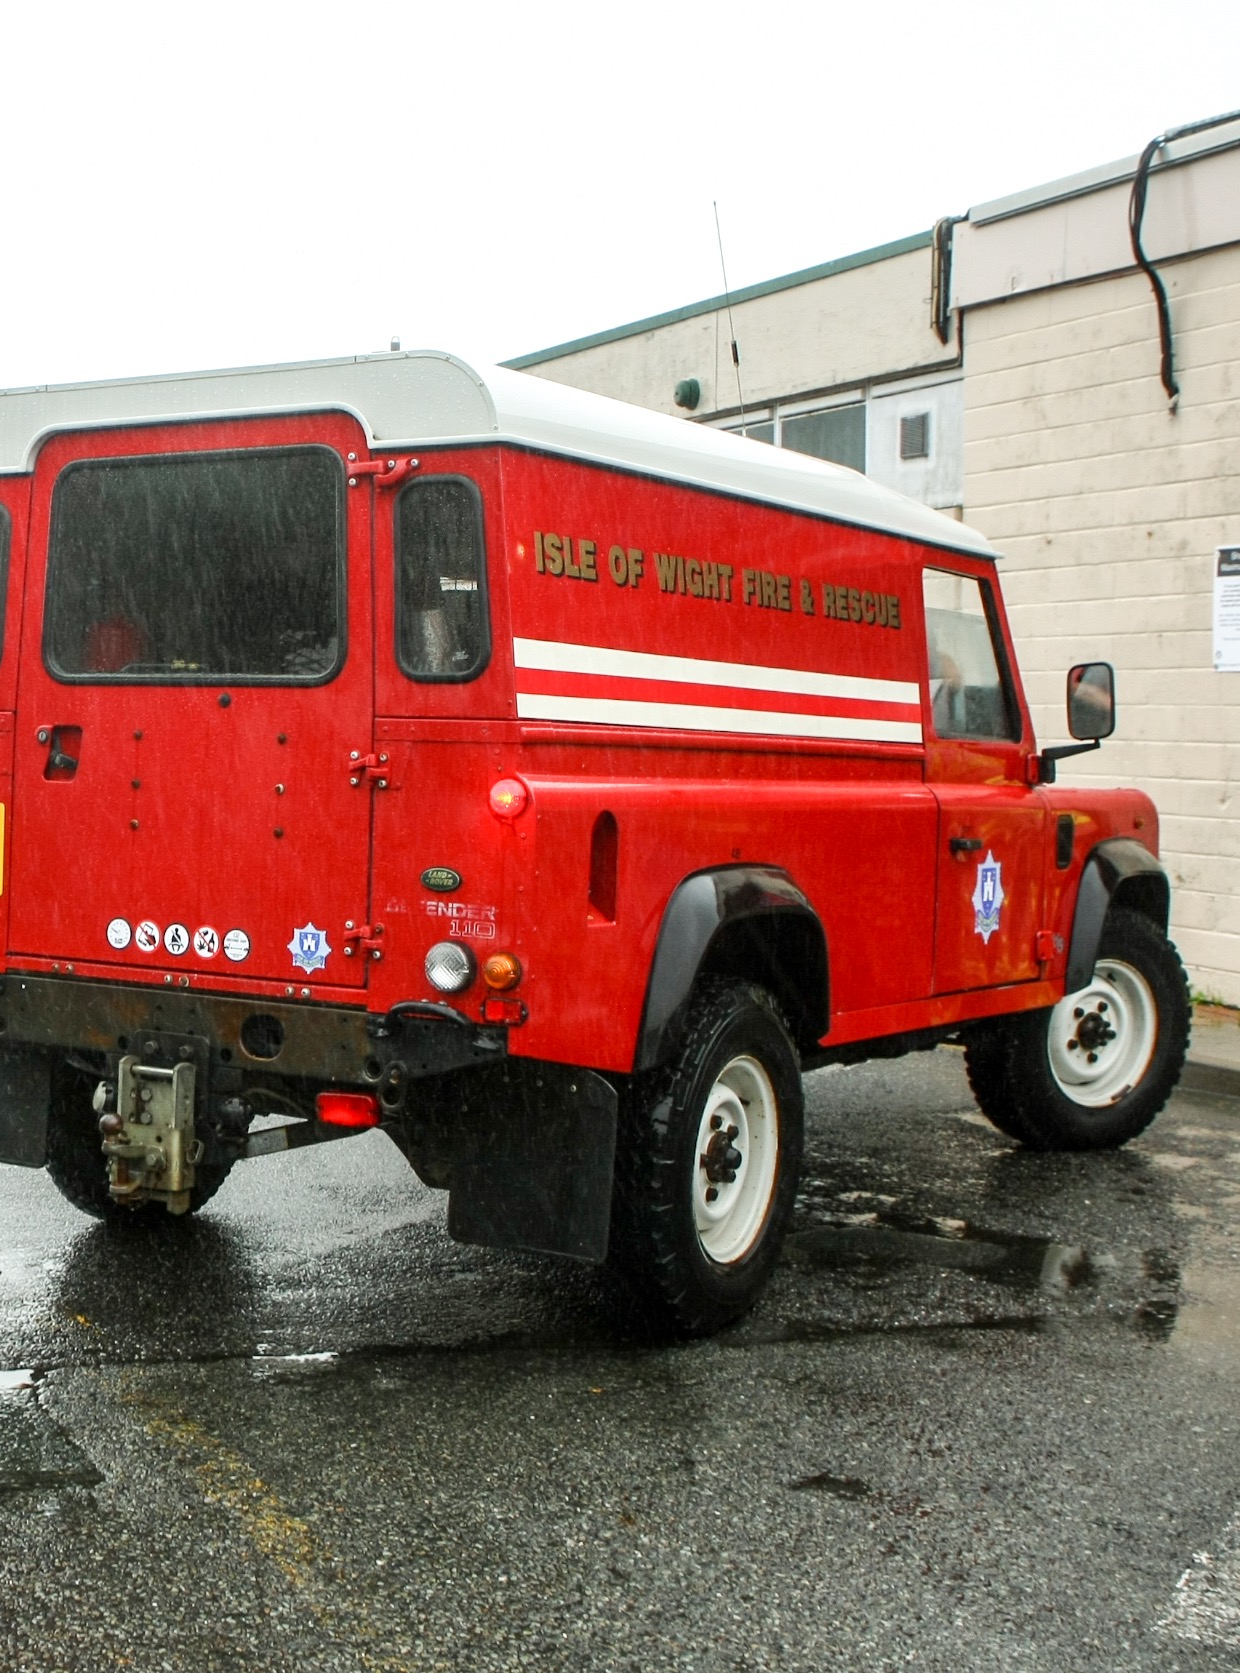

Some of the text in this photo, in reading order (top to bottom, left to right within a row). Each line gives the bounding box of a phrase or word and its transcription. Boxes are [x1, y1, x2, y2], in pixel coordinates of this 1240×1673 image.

[534, 531, 901, 628] ISLE OF WIGHT FIRE & RESCUE
[427, 871, 448, 879] LAND
[429, 878, 454, 886] ROVER
[449, 919, 496, 939] 110
